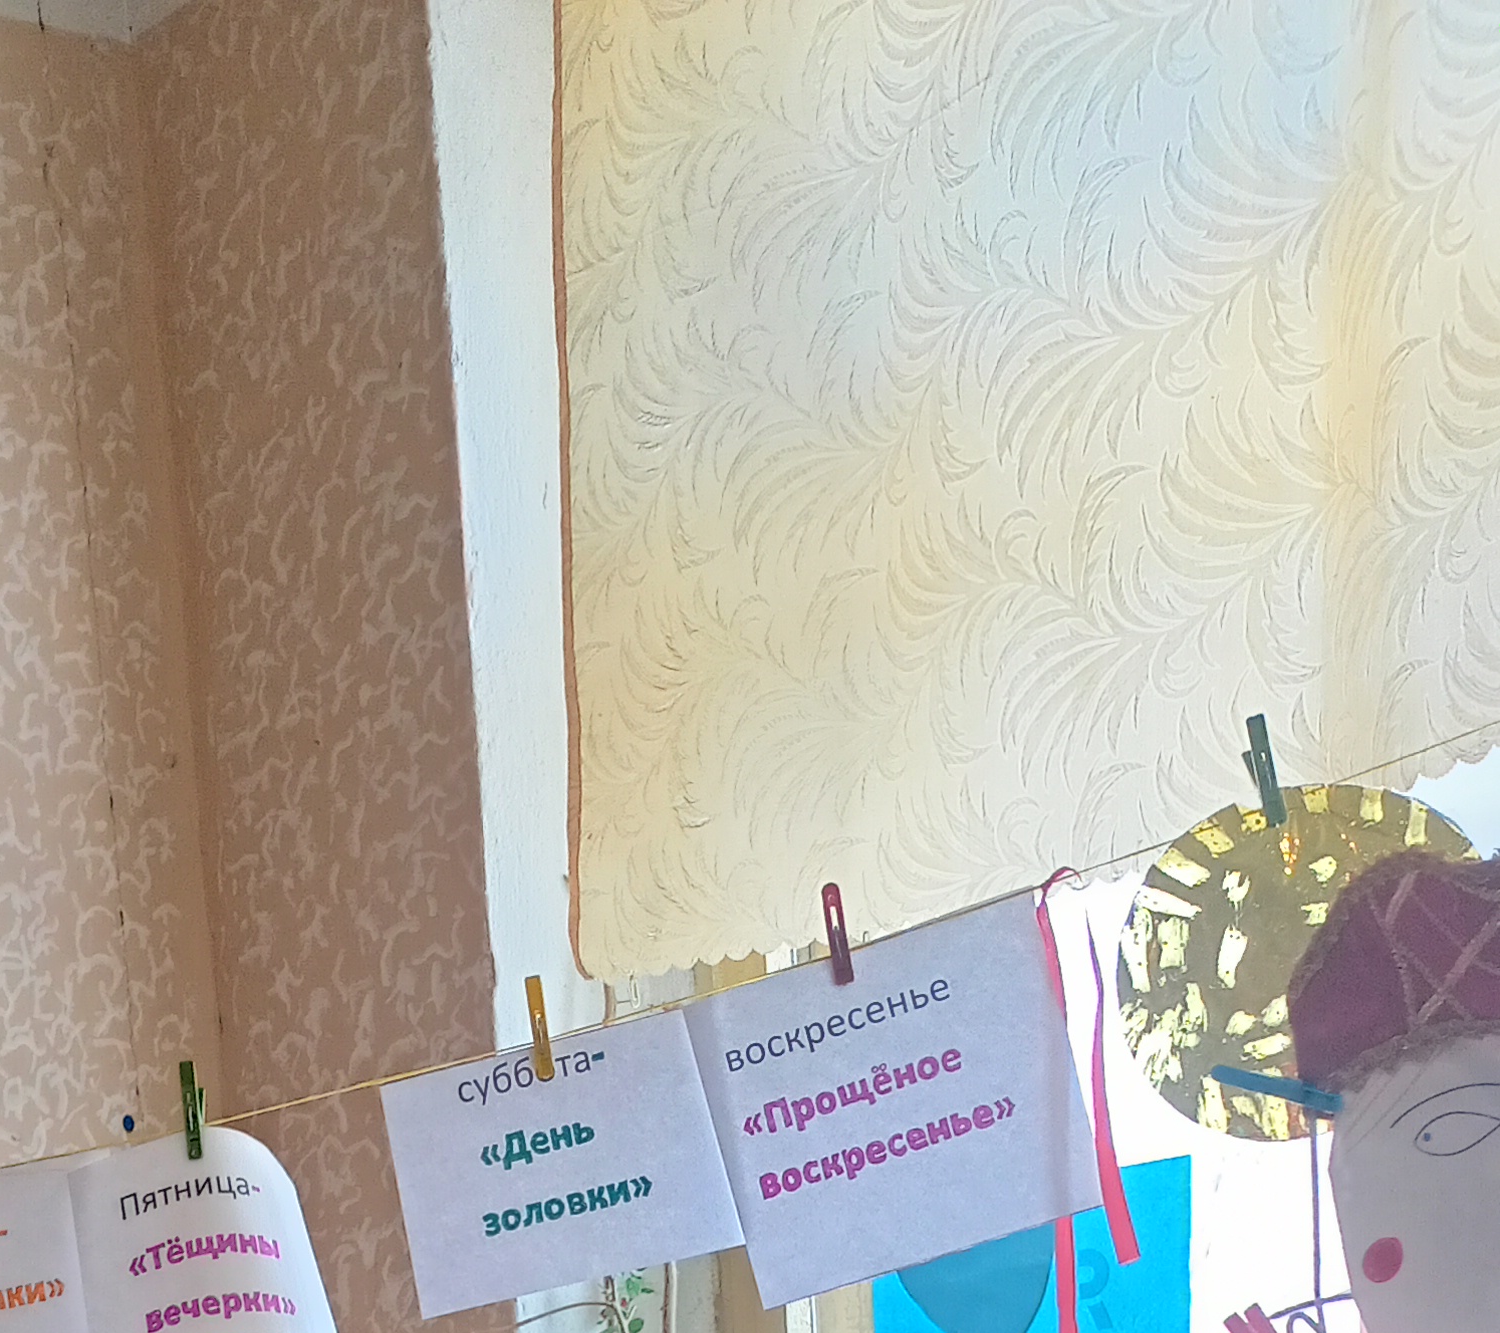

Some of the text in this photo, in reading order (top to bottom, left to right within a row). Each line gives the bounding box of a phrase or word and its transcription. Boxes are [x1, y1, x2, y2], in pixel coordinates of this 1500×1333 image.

[725, 978, 951, 1072] воскресенье
[458, 1050, 605, 1106] суббта-
[743, 1048, 962, 1136] «Прощёное
[480, 1122, 595, 1170] «День
[759, 1096, 1016, 1200] воскресенье»
[120, 1175, 261, 1220] Пятница-
[482, 1175, 653, 1237] золовки»
[129, 1232, 281, 1277] «Тёщины
[145, 1291, 297, 1333] вечерки»
